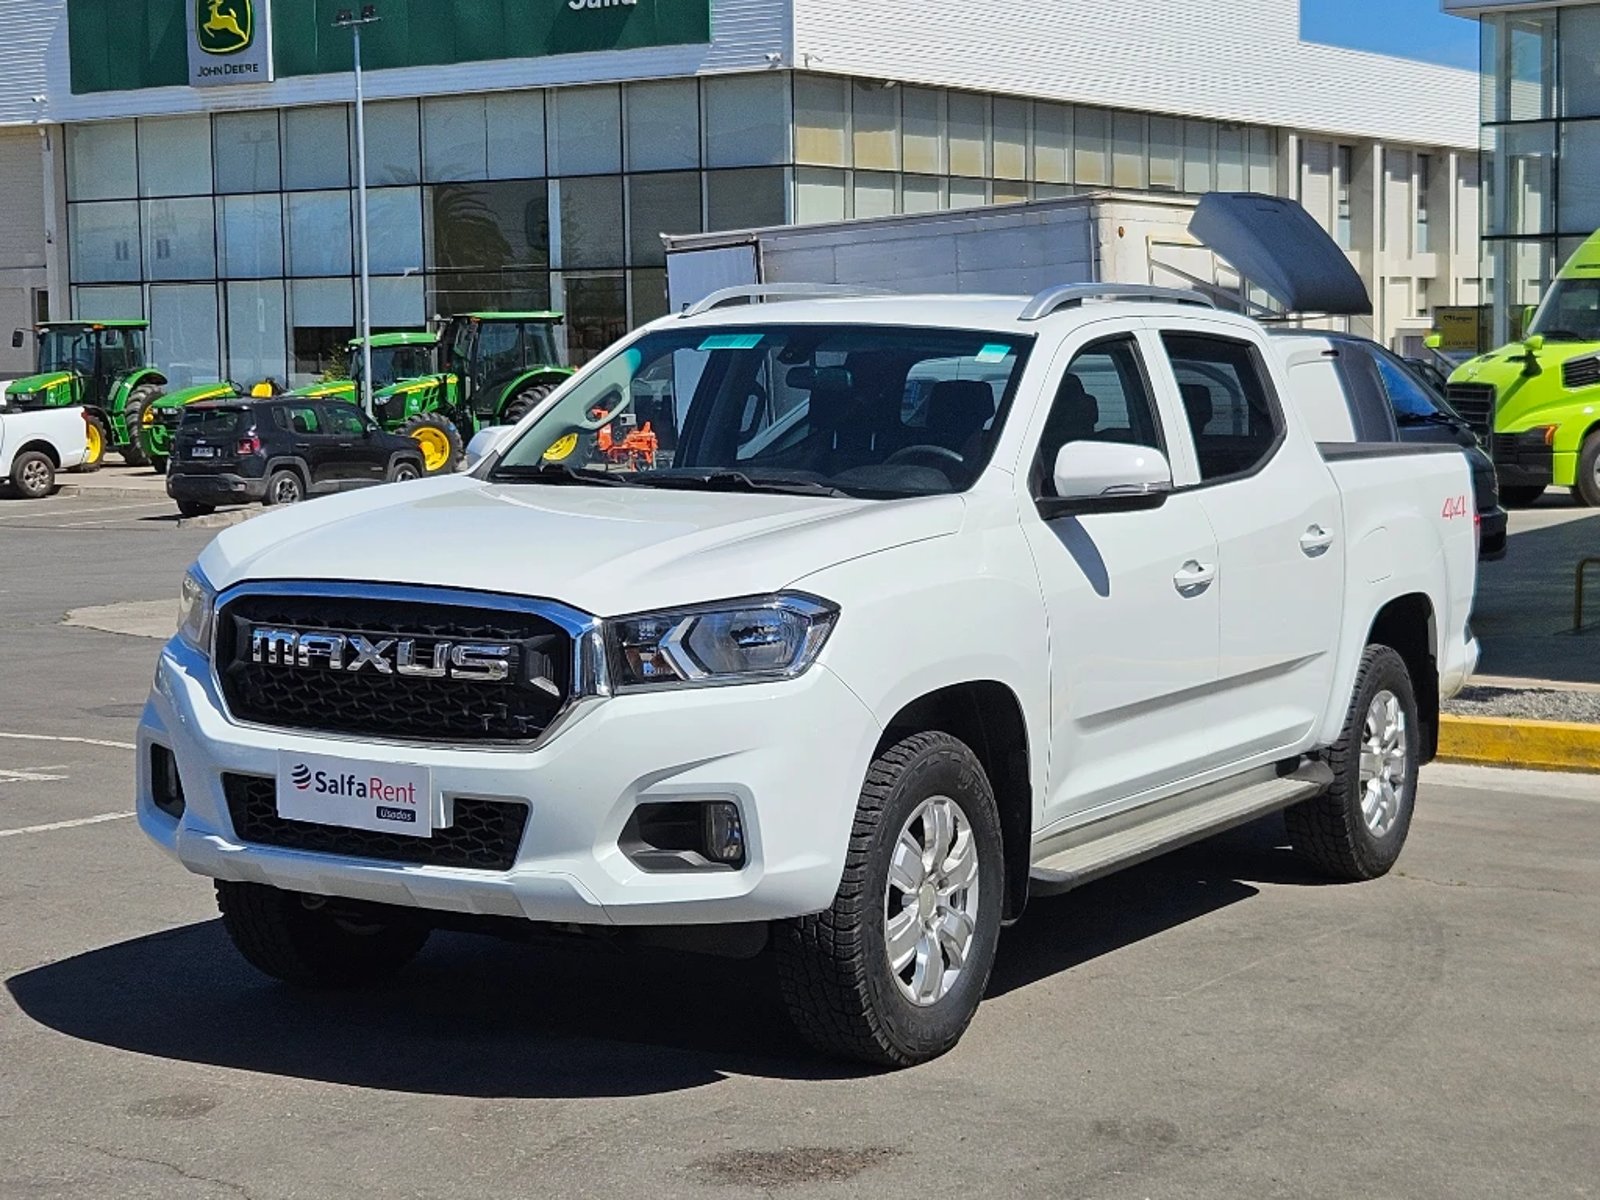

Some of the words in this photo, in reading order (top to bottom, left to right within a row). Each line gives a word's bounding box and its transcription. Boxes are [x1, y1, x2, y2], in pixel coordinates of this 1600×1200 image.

[197, 65, 223, 77] JOHN
[224, 63, 259, 75] DEERE
[252, 627, 511, 681] MAXUS
[315, 771, 416, 804] SalfaRent
[380, 808, 412, 821] Usados
